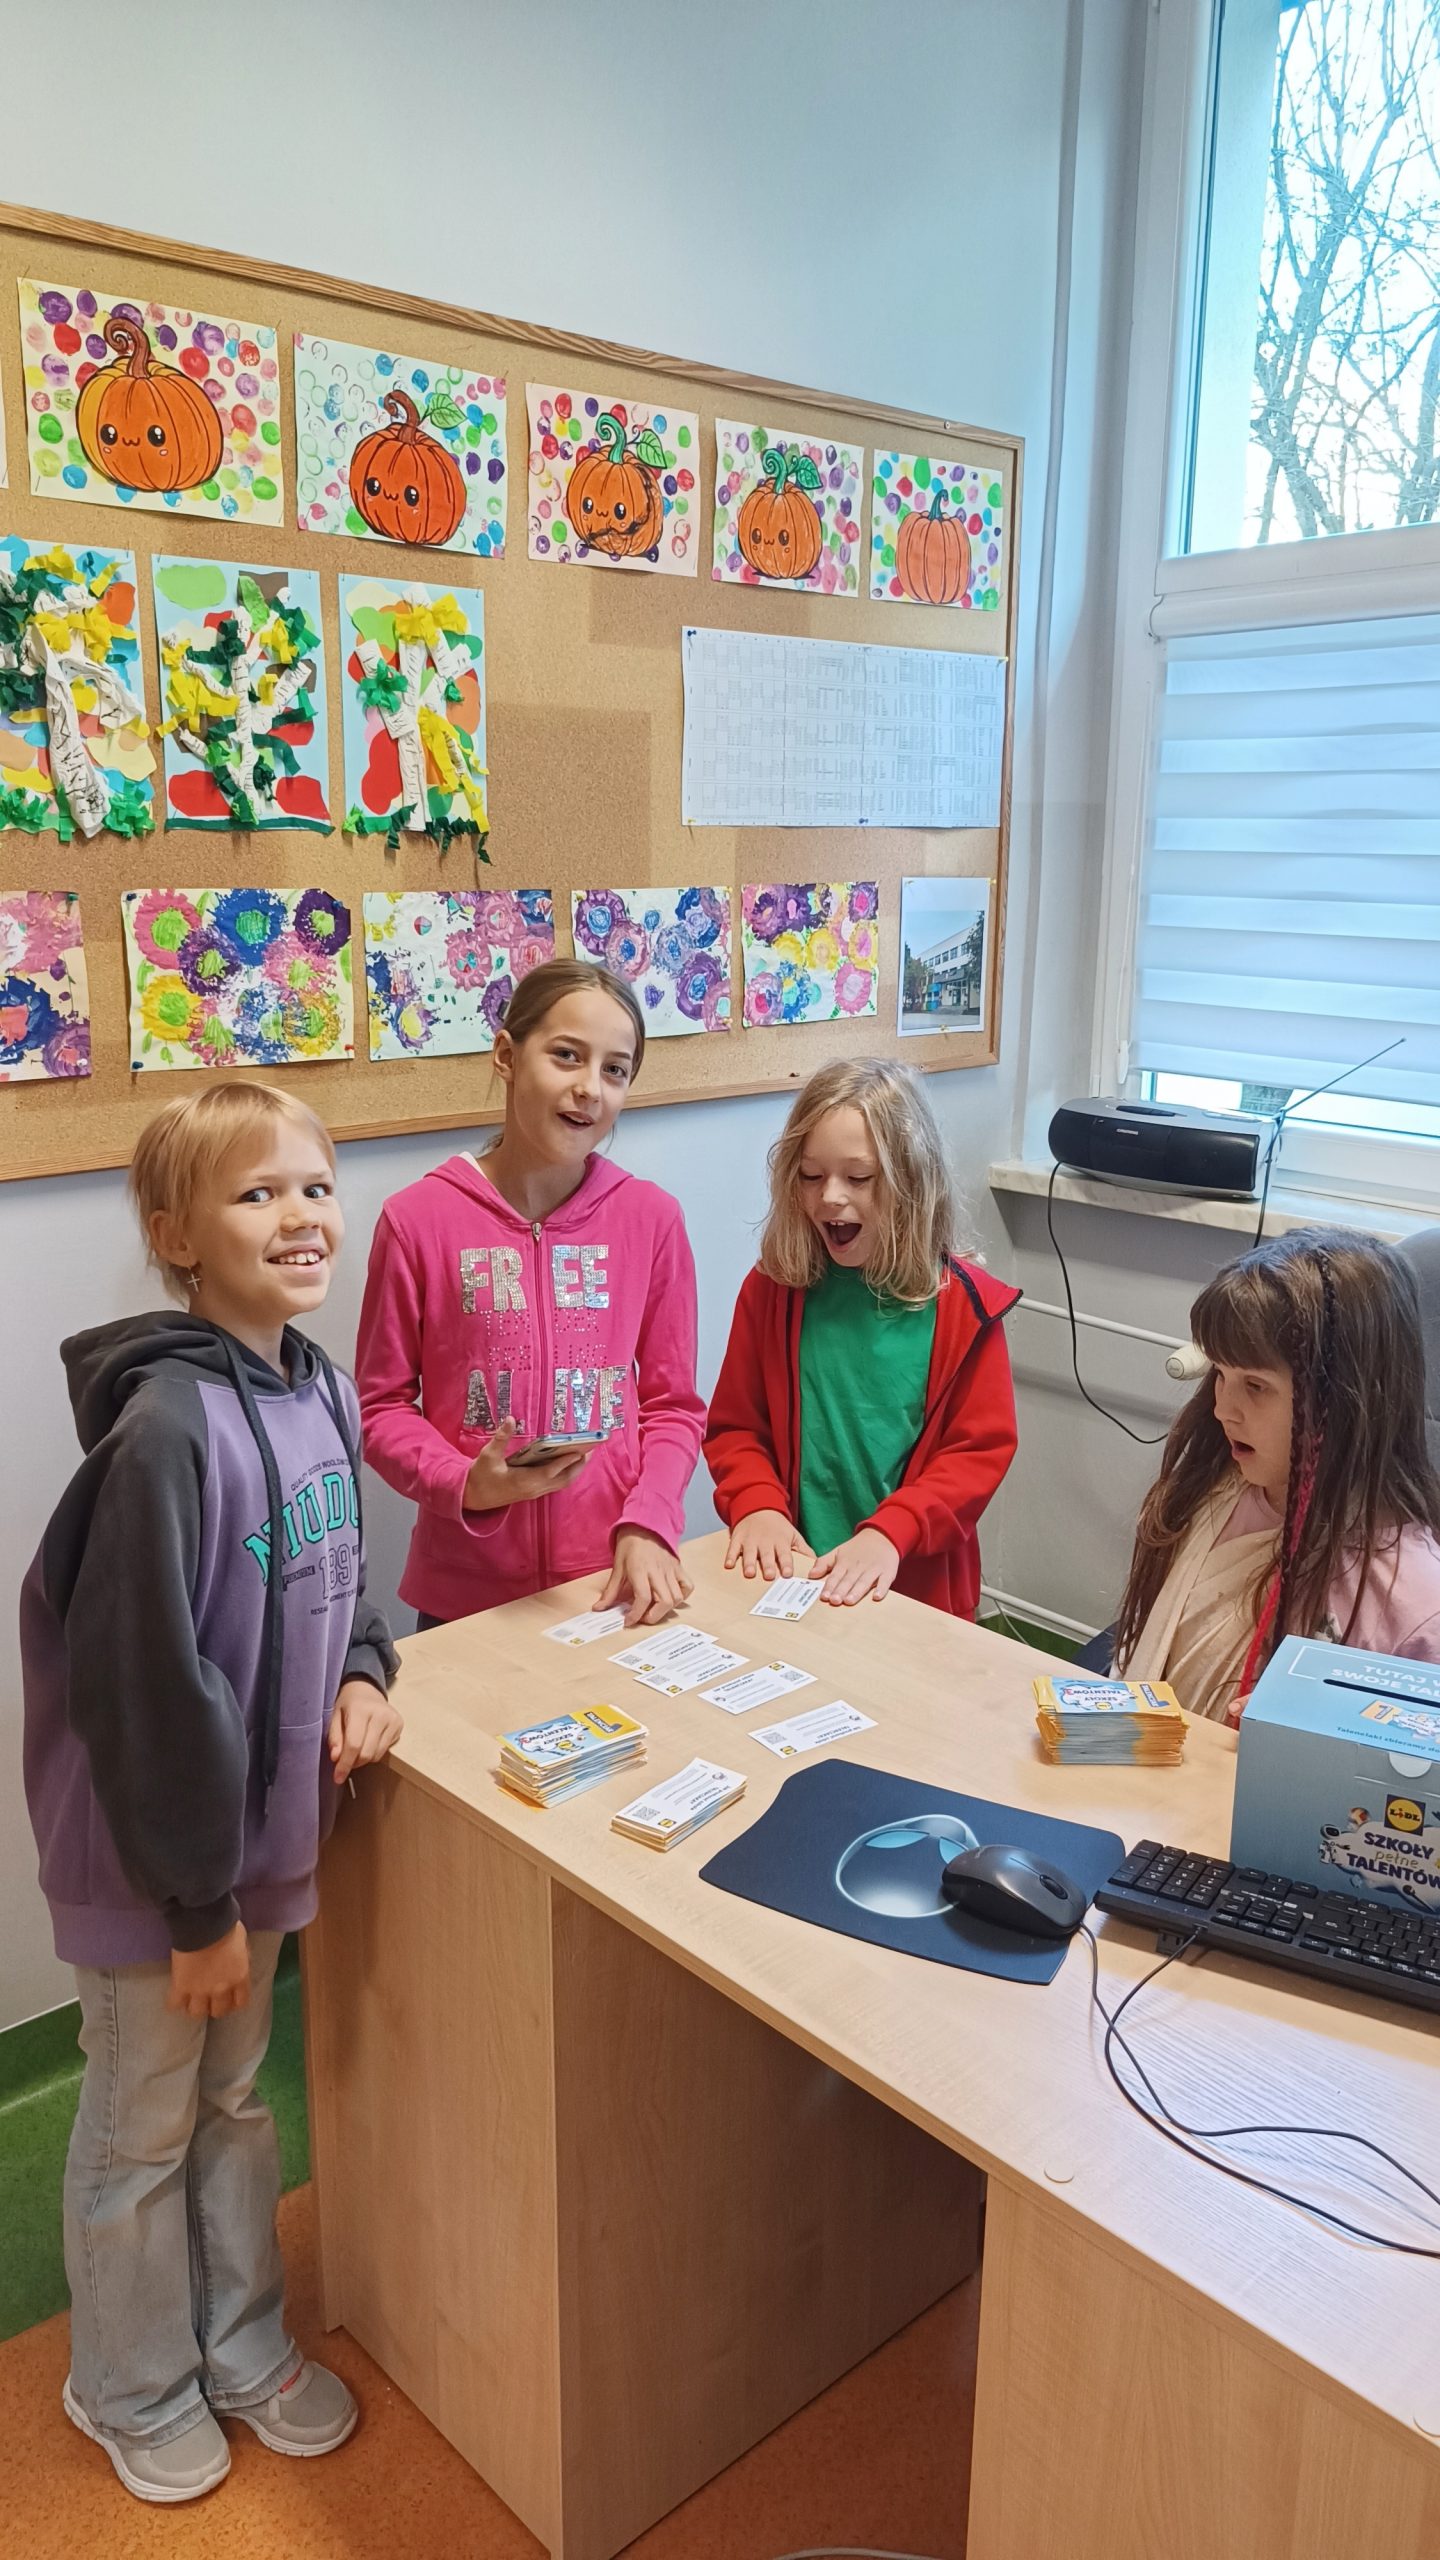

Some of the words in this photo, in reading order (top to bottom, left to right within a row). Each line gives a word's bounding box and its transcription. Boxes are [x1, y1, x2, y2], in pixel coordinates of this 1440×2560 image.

[1331, 1668, 1403, 1689] SWOJE
[1363, 1665, 1427, 1684] TUTAJ
[1363, 1831, 1435, 1860] SZKOŁY
[1374, 1850, 1419, 1869] pełne
[1346, 1852, 1440, 1890] TALENTÓW
